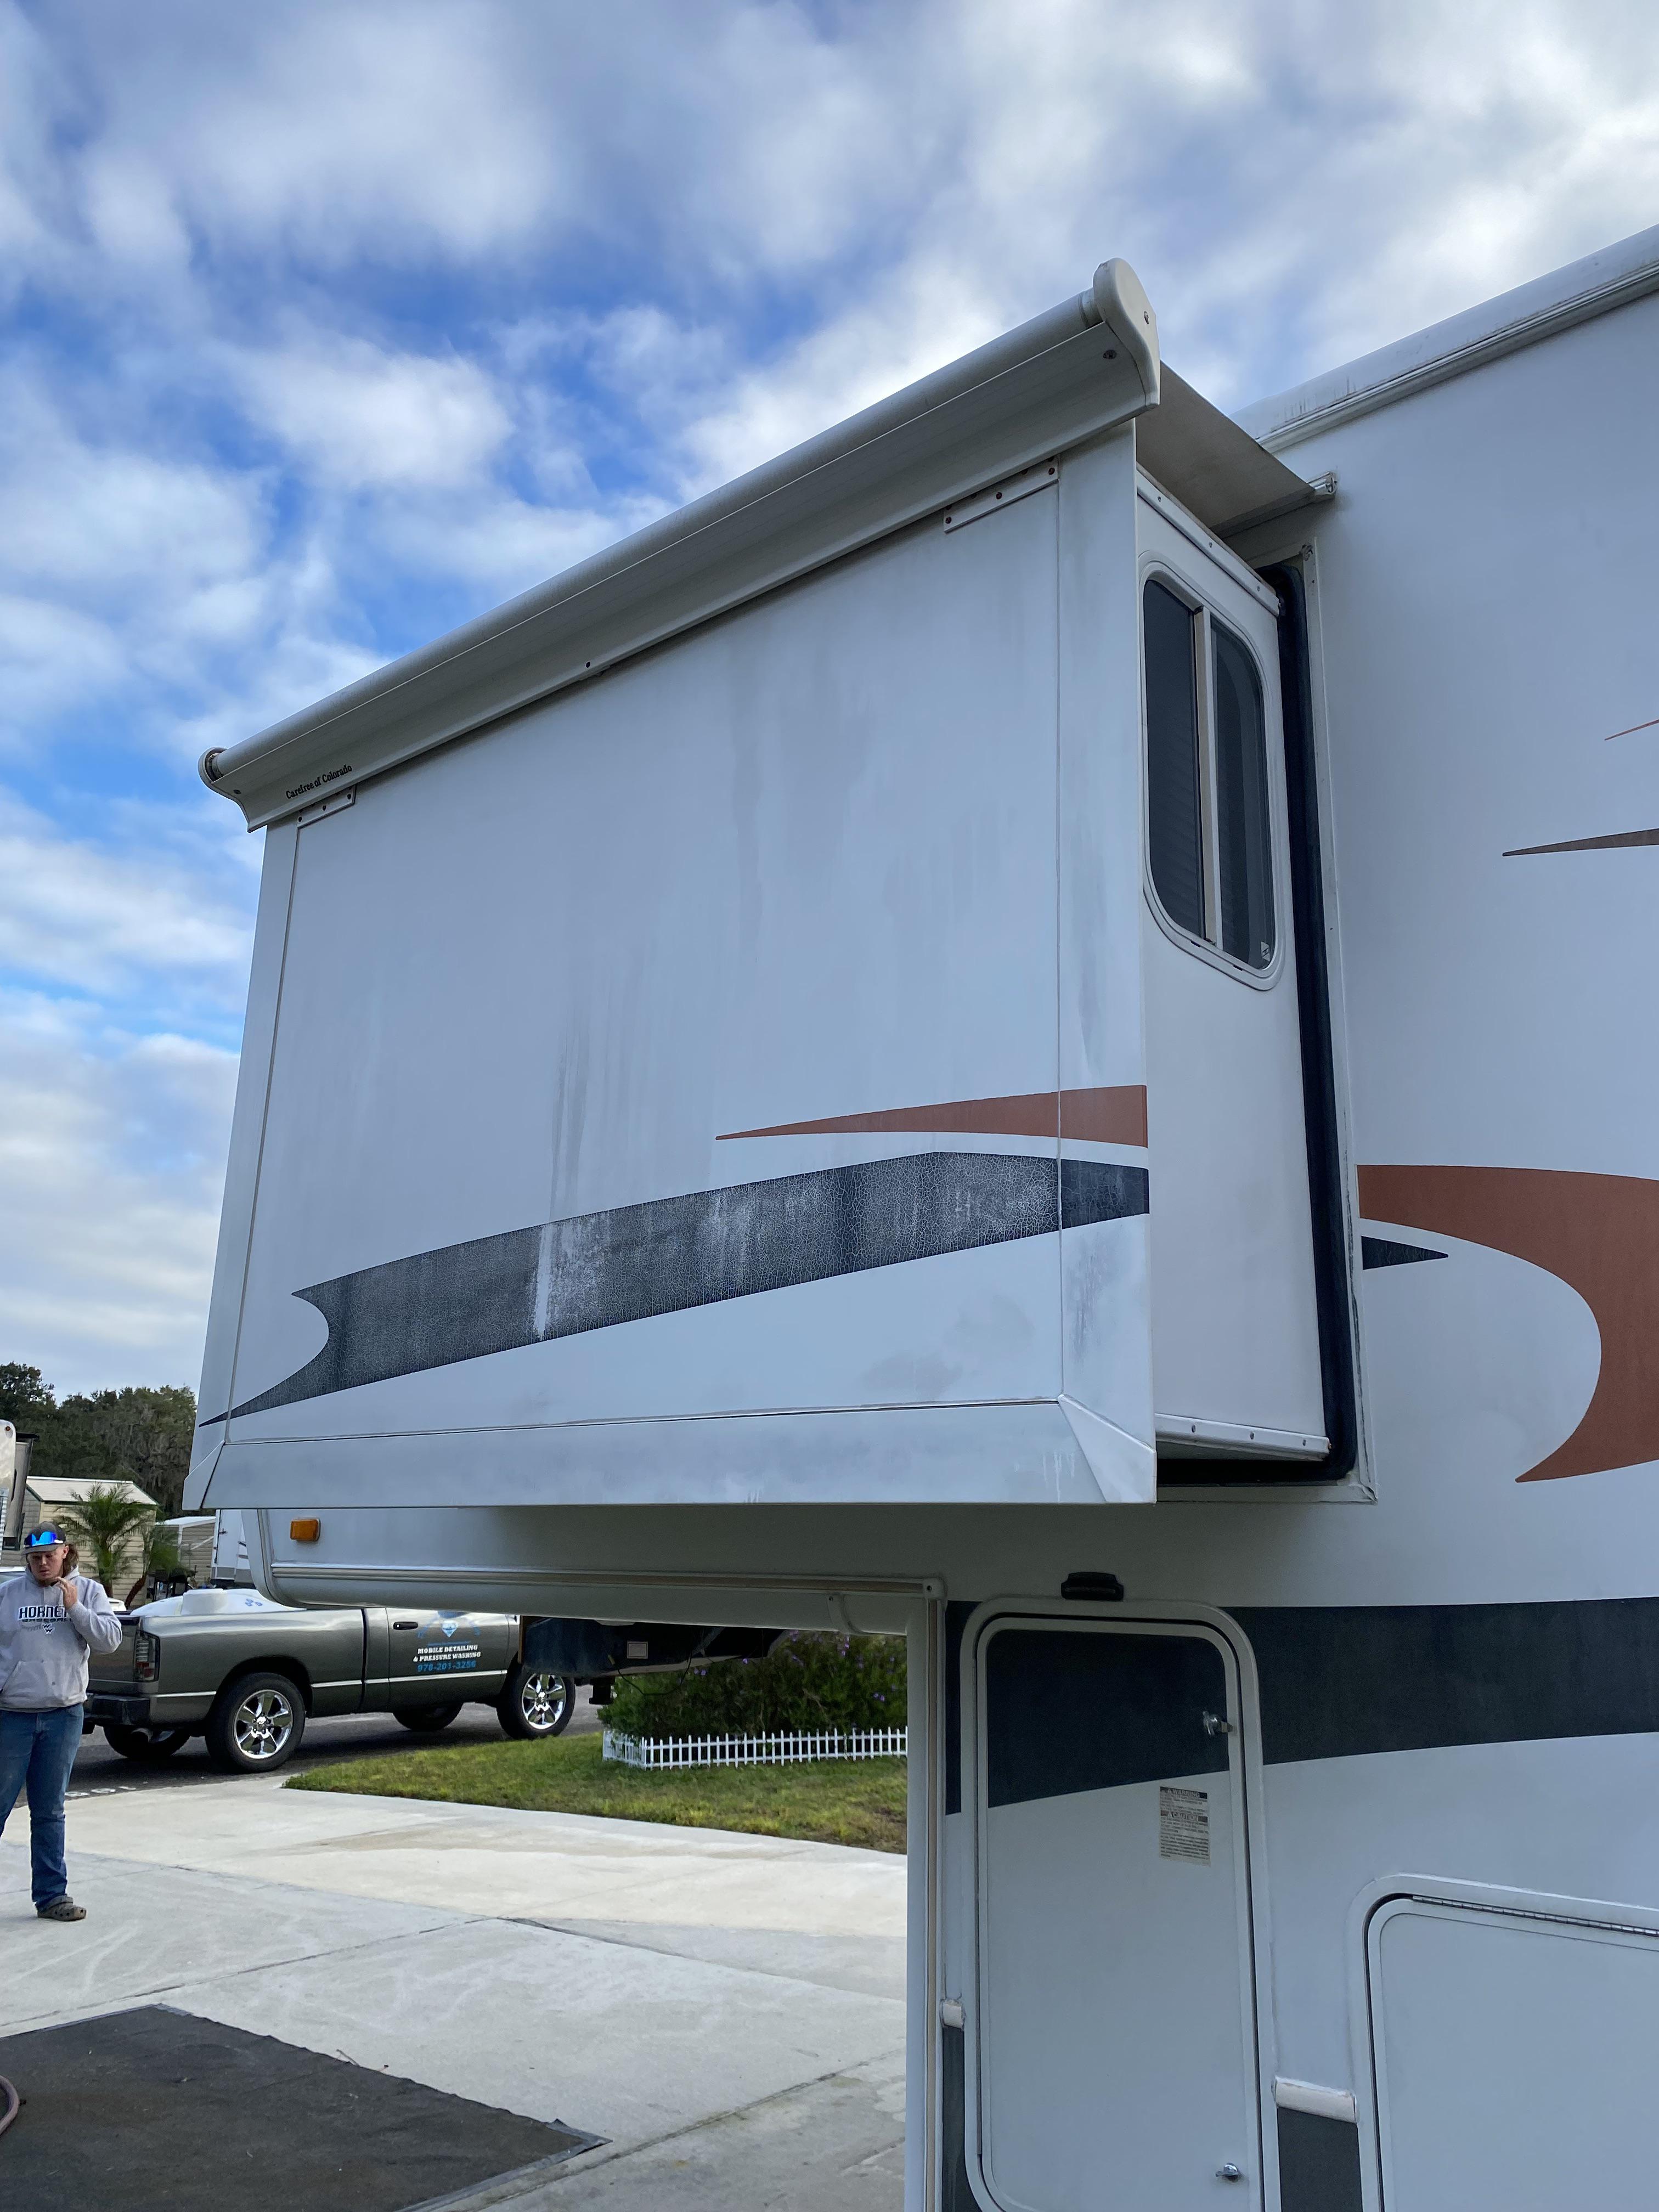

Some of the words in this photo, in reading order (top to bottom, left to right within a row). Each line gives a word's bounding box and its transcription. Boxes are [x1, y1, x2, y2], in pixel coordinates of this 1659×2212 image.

[286, 785, 314, 799] Carefree
[314, 777, 321, 787] of
[323, 764, 352, 782] Colorado
[1173, 1788, 1200, 1798] WARNING
[1173, 1812, 1199, 1821] CAUTION
